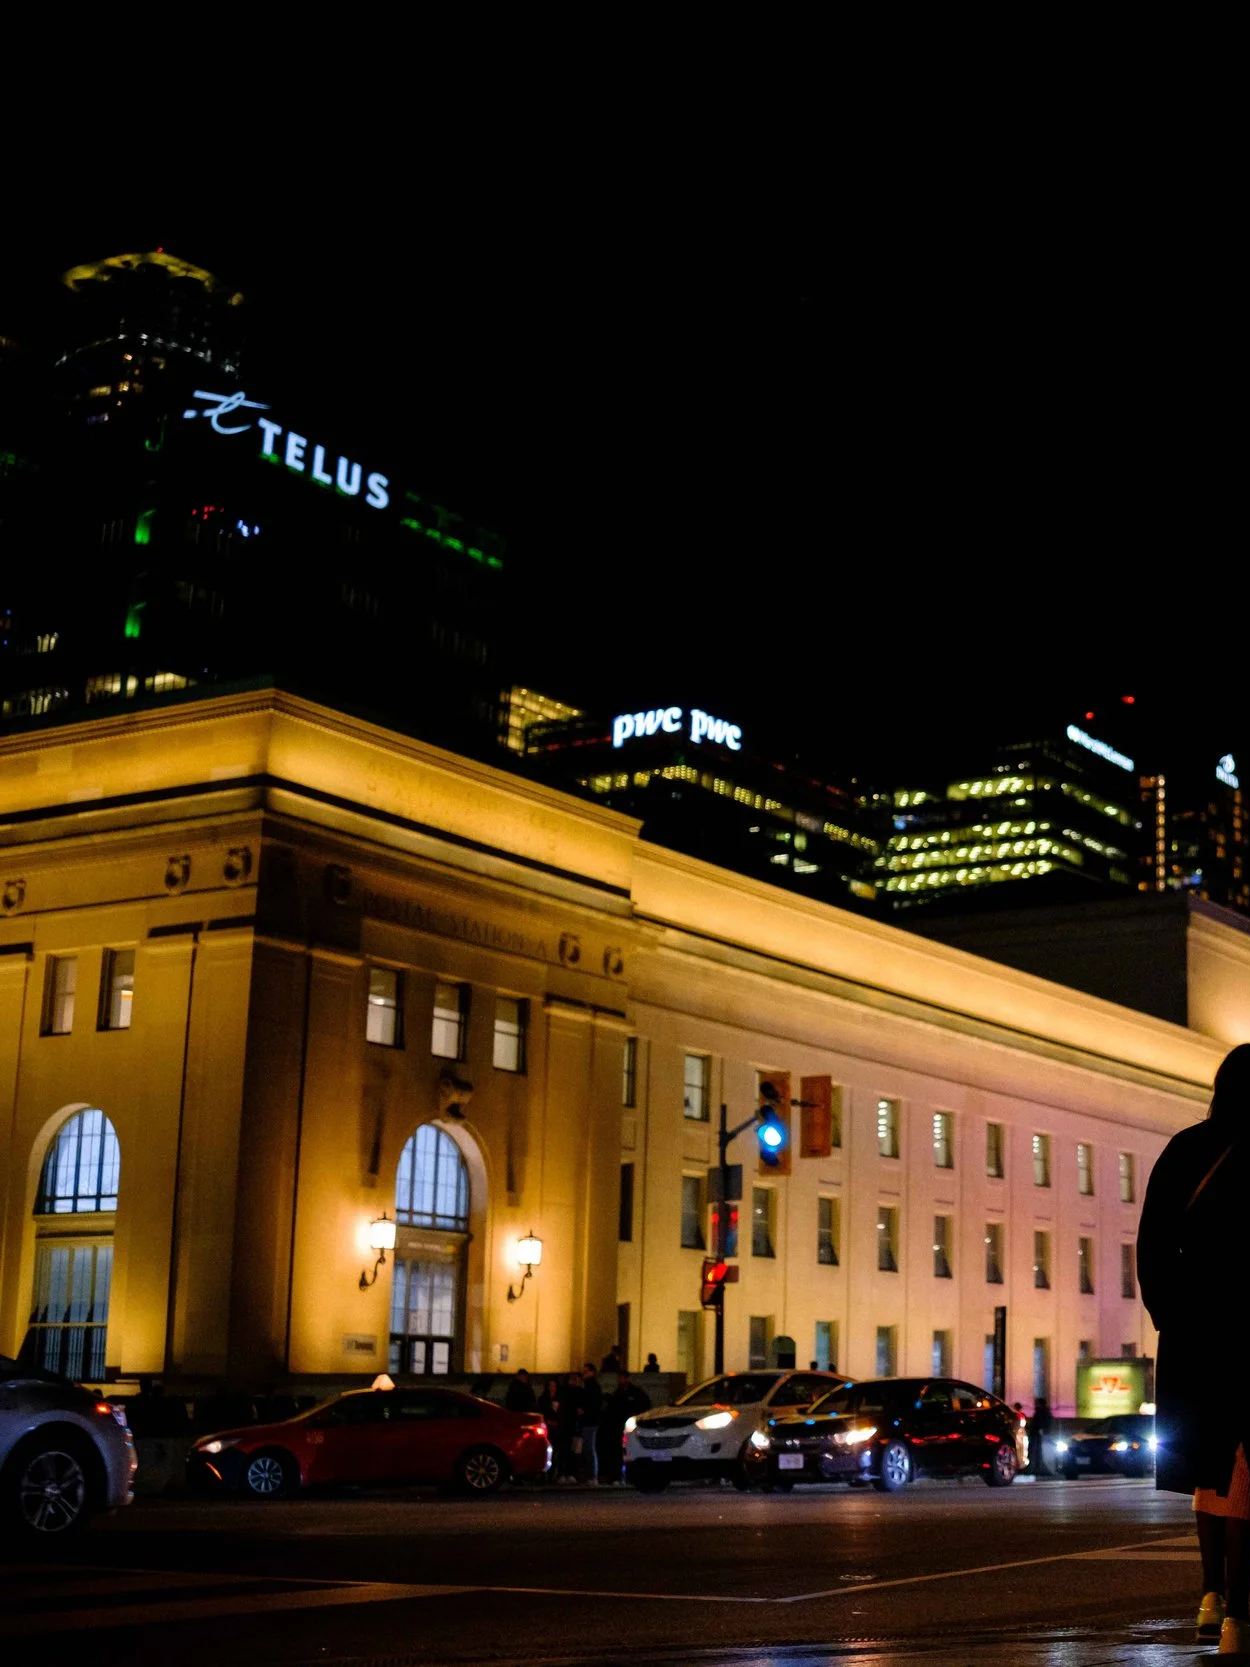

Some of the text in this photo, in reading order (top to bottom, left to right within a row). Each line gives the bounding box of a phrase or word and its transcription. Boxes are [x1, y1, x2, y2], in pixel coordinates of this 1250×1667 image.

[258, 417, 390, 510] TELUS
[613, 707, 682, 748] pwc
[690, 709, 742, 751] pwc
[448, 911, 525, 952] STATION
